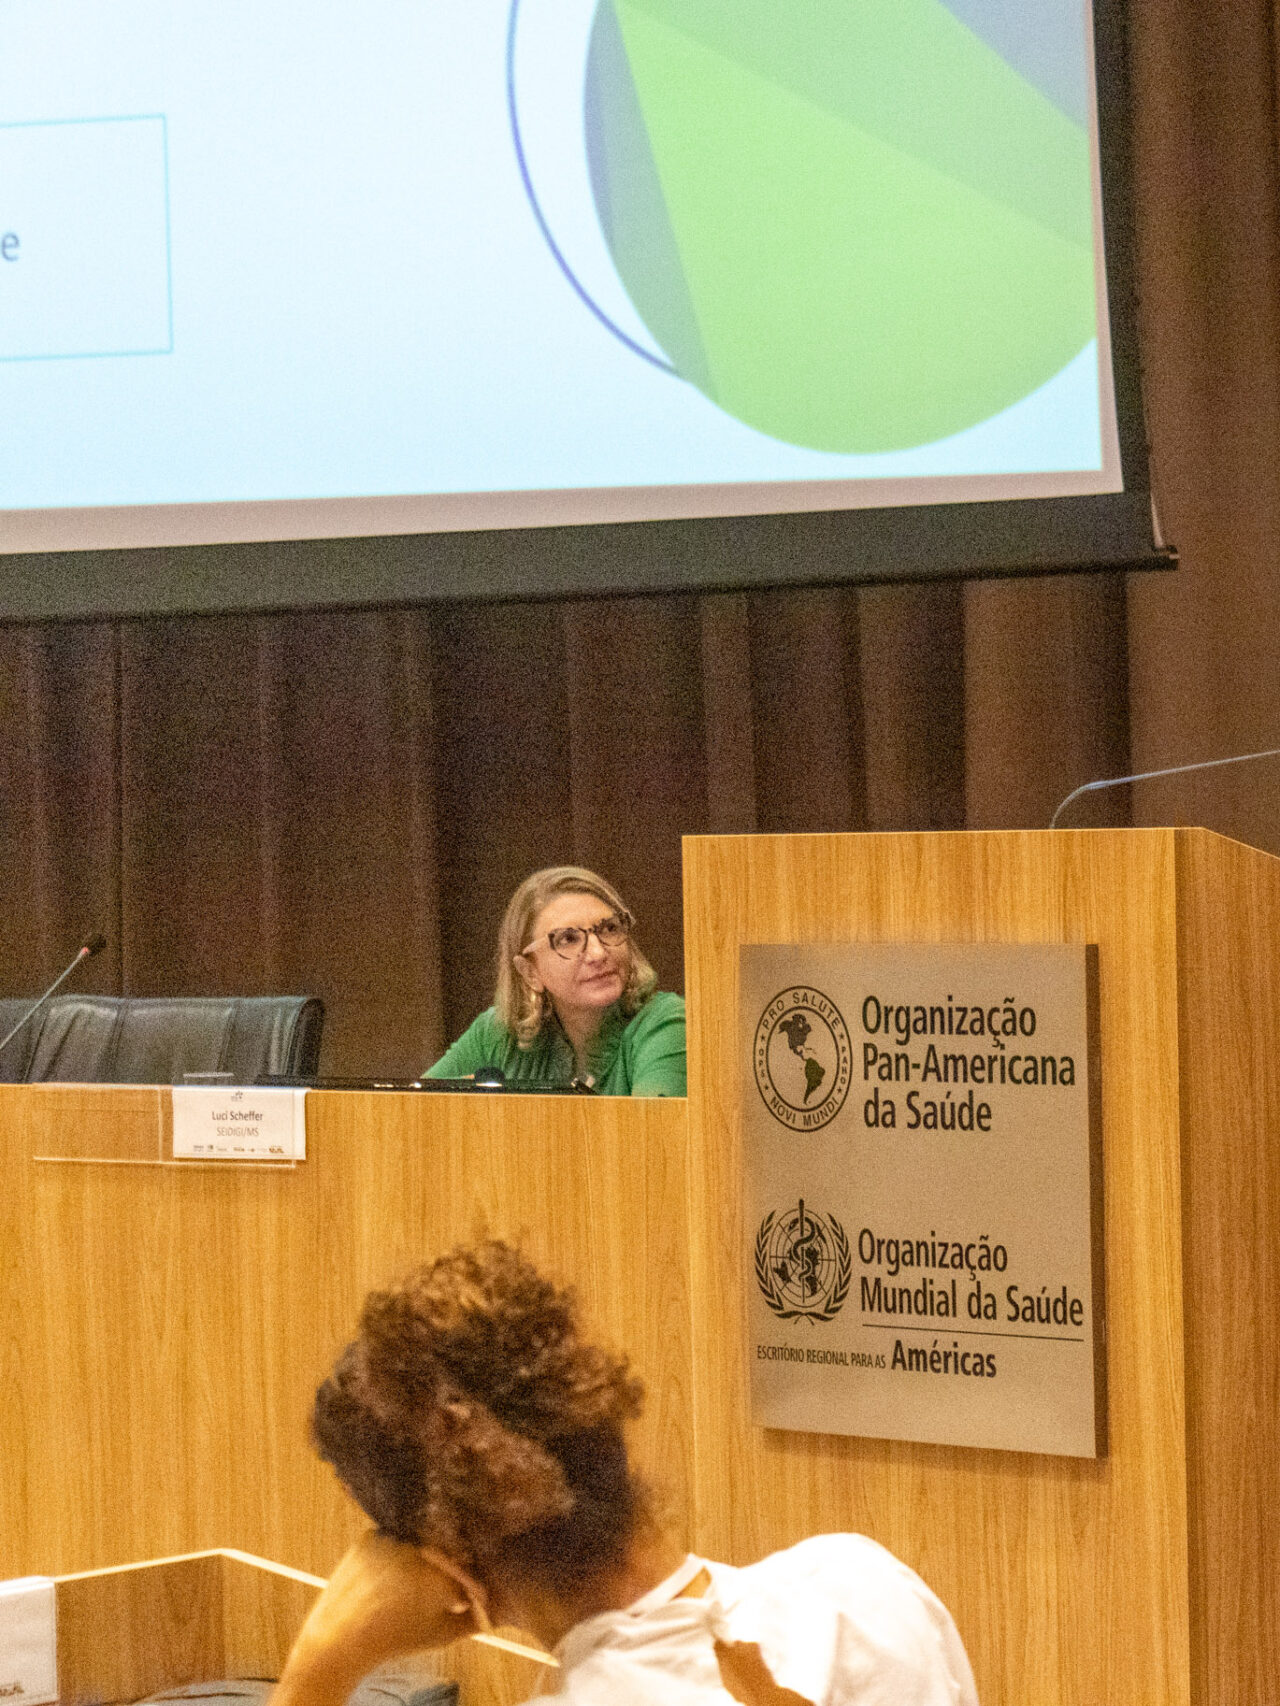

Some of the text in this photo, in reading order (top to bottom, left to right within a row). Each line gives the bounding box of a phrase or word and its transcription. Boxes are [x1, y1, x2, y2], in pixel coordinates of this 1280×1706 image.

[762, 991, 840, 1030] PRO SALUTE
[862, 995, 1036, 1047] Organização
[863, 1042, 1076, 1086] Pan-Americana
[212, 1110, 263, 1121] Luci Scheffer
[770, 1096, 839, 1127] NOVI MUNDI
[864, 1087, 992, 1132] da Saúde
[858, 1228, 1008, 1281] Organização
[860, 1276, 1084, 1326] Mundial da Saúde
[757, 1339, 997, 1378] ESCRITÓRIO REGIONAL PARA AS Américas
